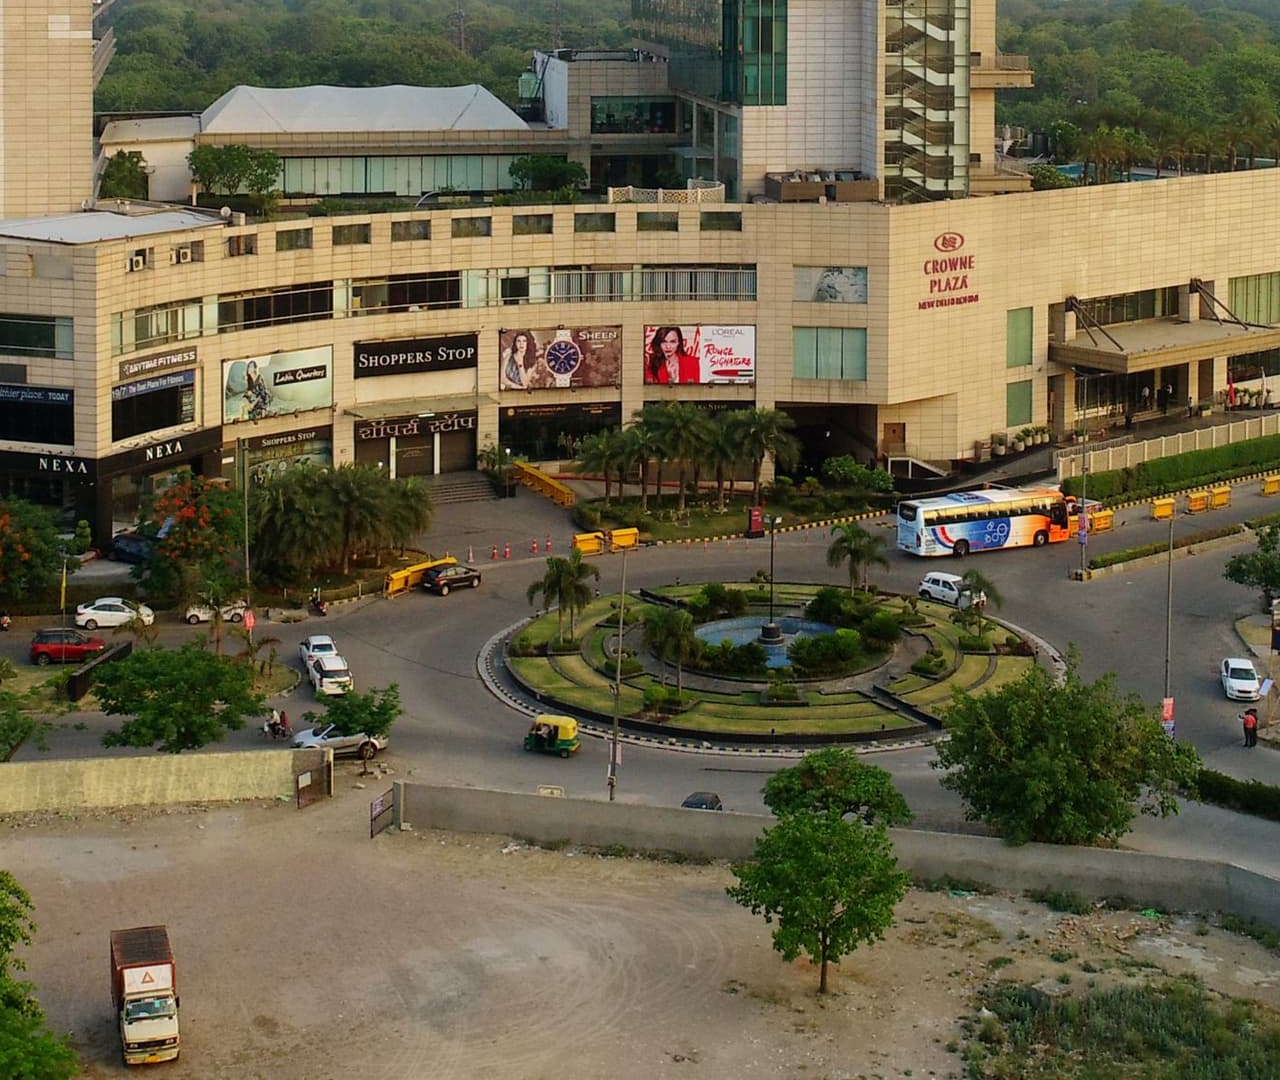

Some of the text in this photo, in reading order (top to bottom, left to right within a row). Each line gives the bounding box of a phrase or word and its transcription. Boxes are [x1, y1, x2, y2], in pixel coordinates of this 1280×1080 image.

[923, 255, 975, 275] CROWNE
[930, 275, 968, 294] PLAZA
[579, 331, 617, 340] SHEEN
[129, 351, 196, 374] ANYTIME FITNESS
[359, 347, 475, 368] SHOPPERS STOP
[48, 392, 69, 401] TODAY
[146, 441, 183, 461] NEXA
[39, 457, 88, 474] NEXA
